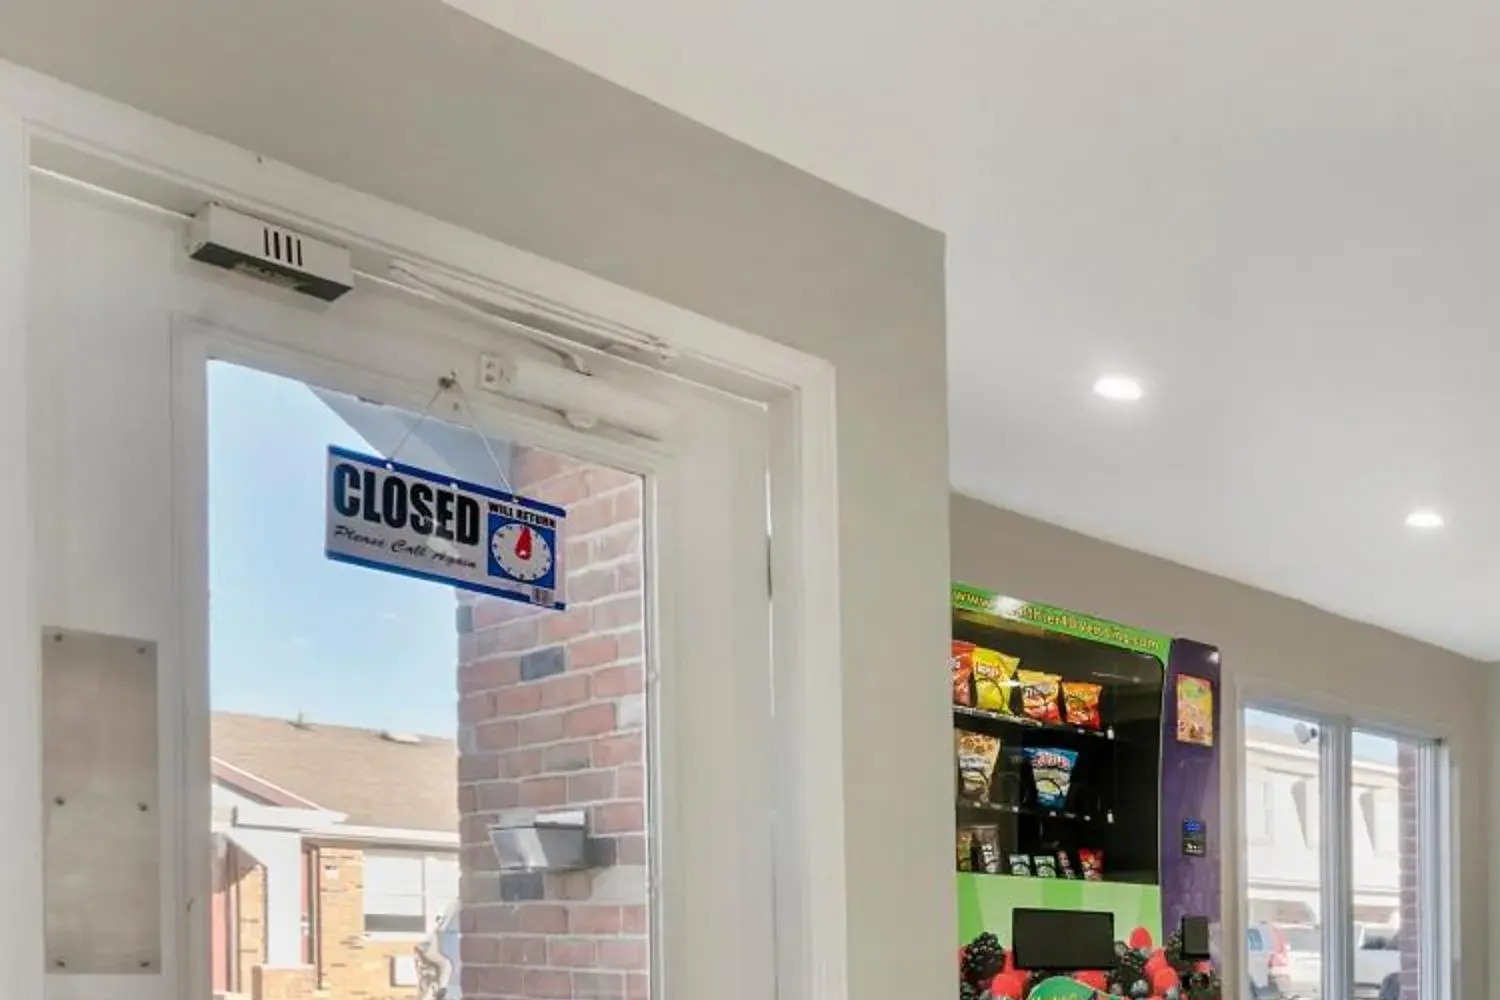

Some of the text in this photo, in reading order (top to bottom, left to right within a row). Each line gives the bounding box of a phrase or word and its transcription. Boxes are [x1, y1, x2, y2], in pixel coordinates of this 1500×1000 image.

[333, 463, 481, 547] CLOSED
[488, 500, 513, 519] WILL
[391, 537, 426, 557] Call
